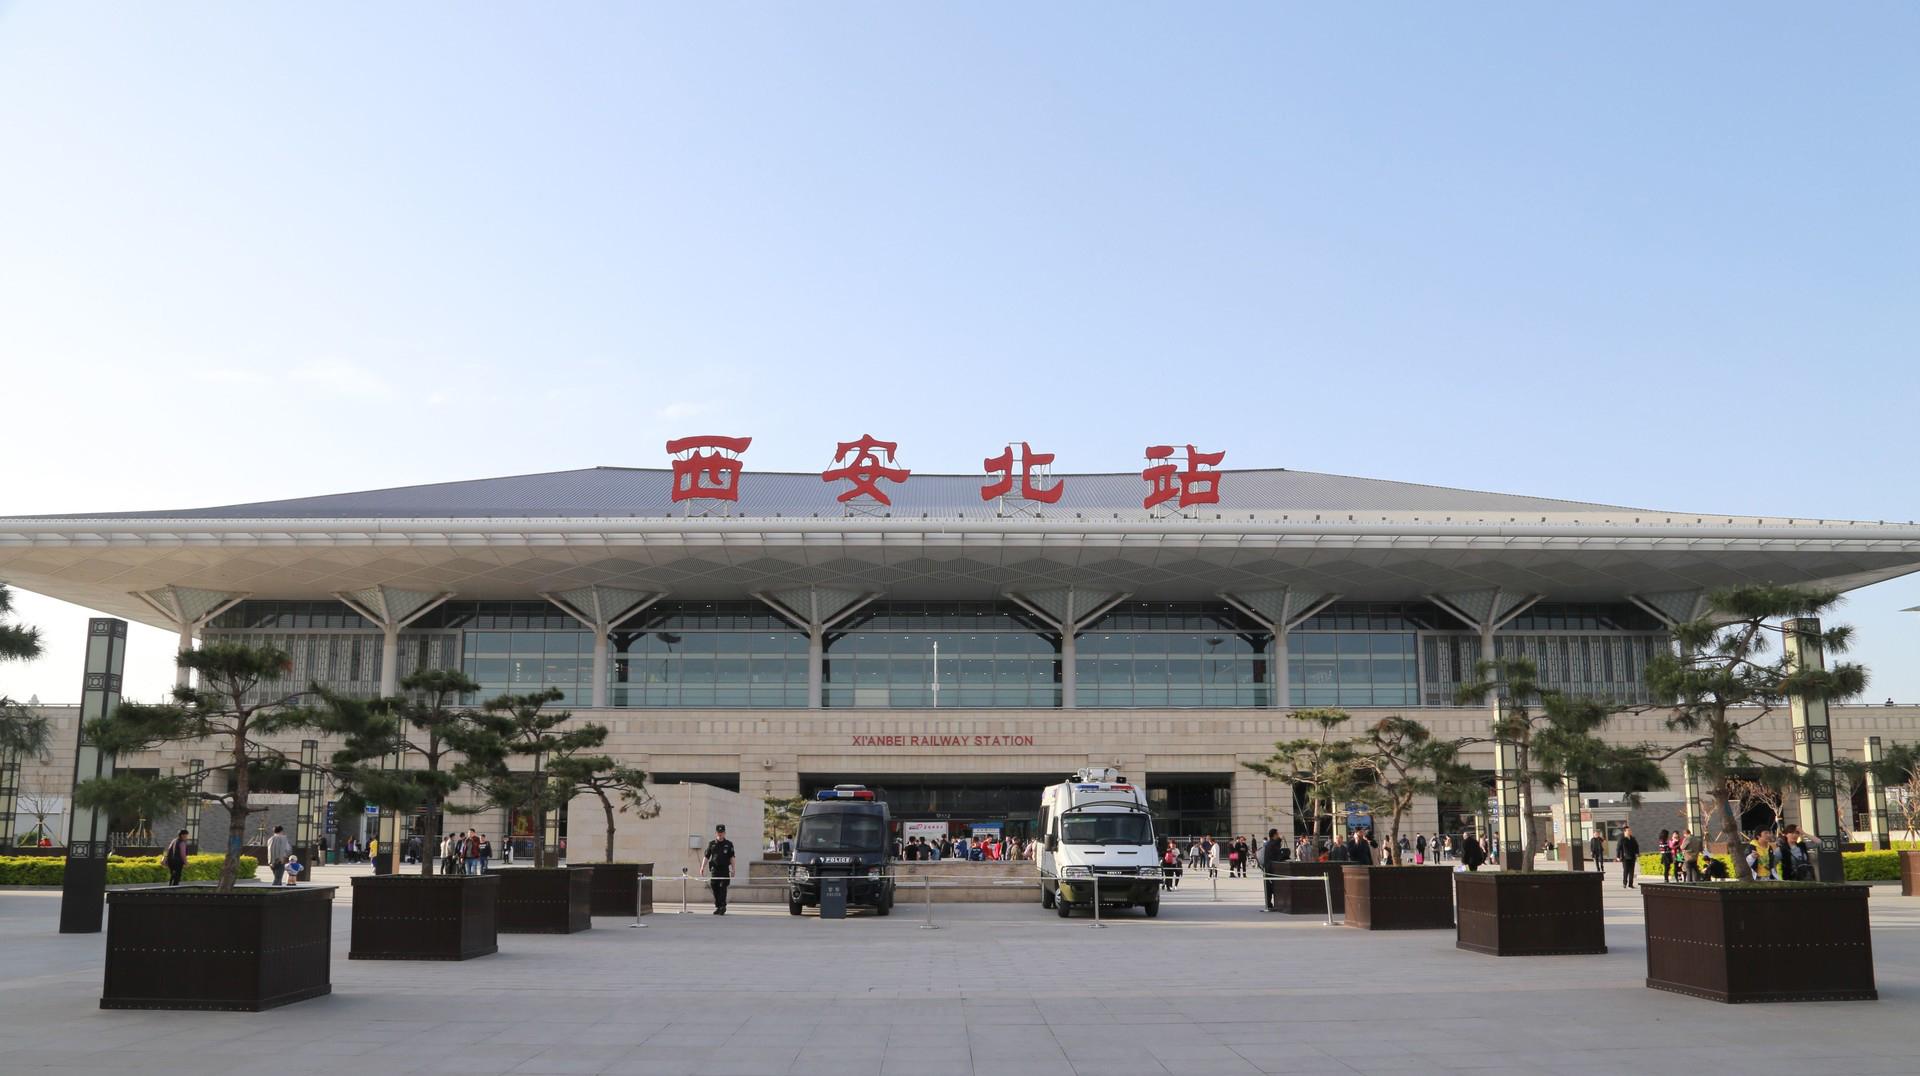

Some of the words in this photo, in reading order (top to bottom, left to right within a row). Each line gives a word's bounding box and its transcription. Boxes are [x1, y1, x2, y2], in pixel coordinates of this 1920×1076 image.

[667, 435, 1225, 509] 西安北站
[852, 735, 906, 746] XI'ANBEI
[911, 735, 969, 746] RAILWAY
[974, 735, 1033, 746] STATION
